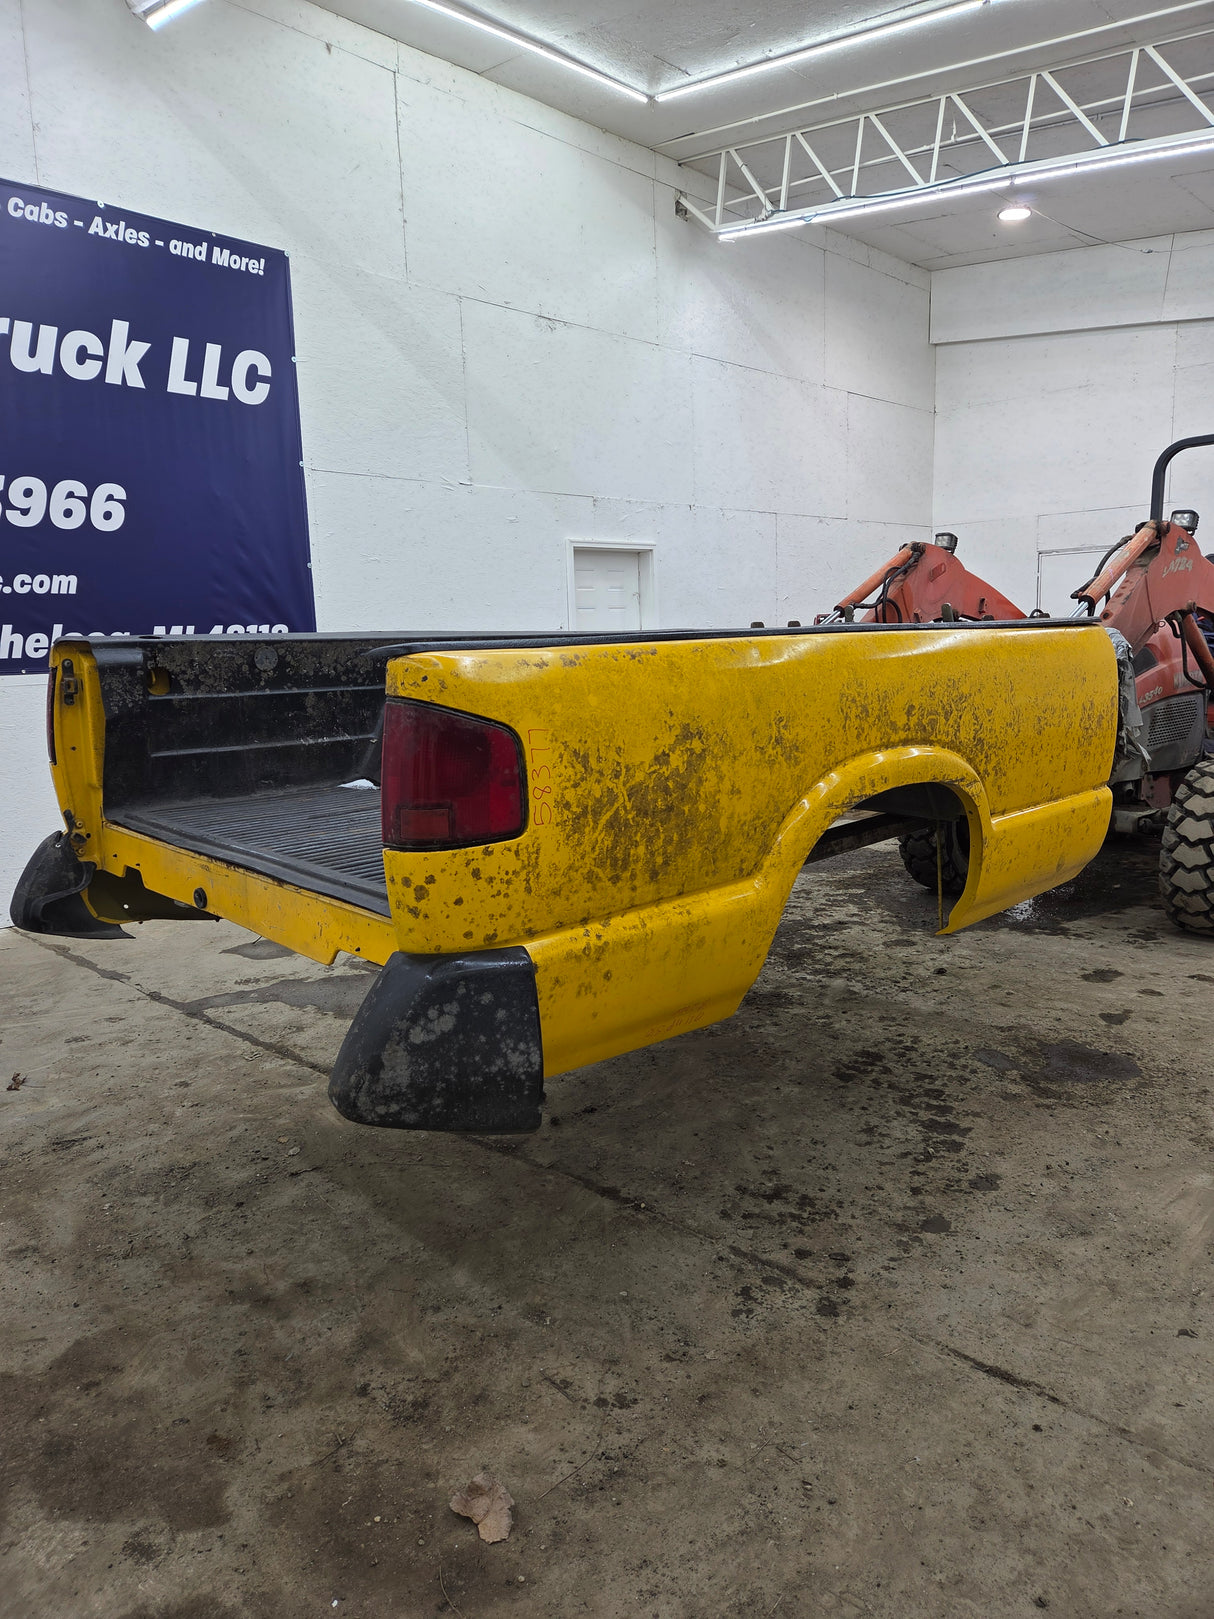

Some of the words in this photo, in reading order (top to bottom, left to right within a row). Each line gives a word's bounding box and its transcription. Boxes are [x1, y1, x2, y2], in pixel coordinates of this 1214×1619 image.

[7, 196, 69, 228] Cabs
[87, 215, 150, 248] Axles
[169, 232, 208, 261] and
[211, 246, 266, 276] More!
[166, 336, 272, 405] LLC
[0, 474, 127, 532] 966
[0, 573, 78, 595] .com
[527, 728, 553, 826] 58377
